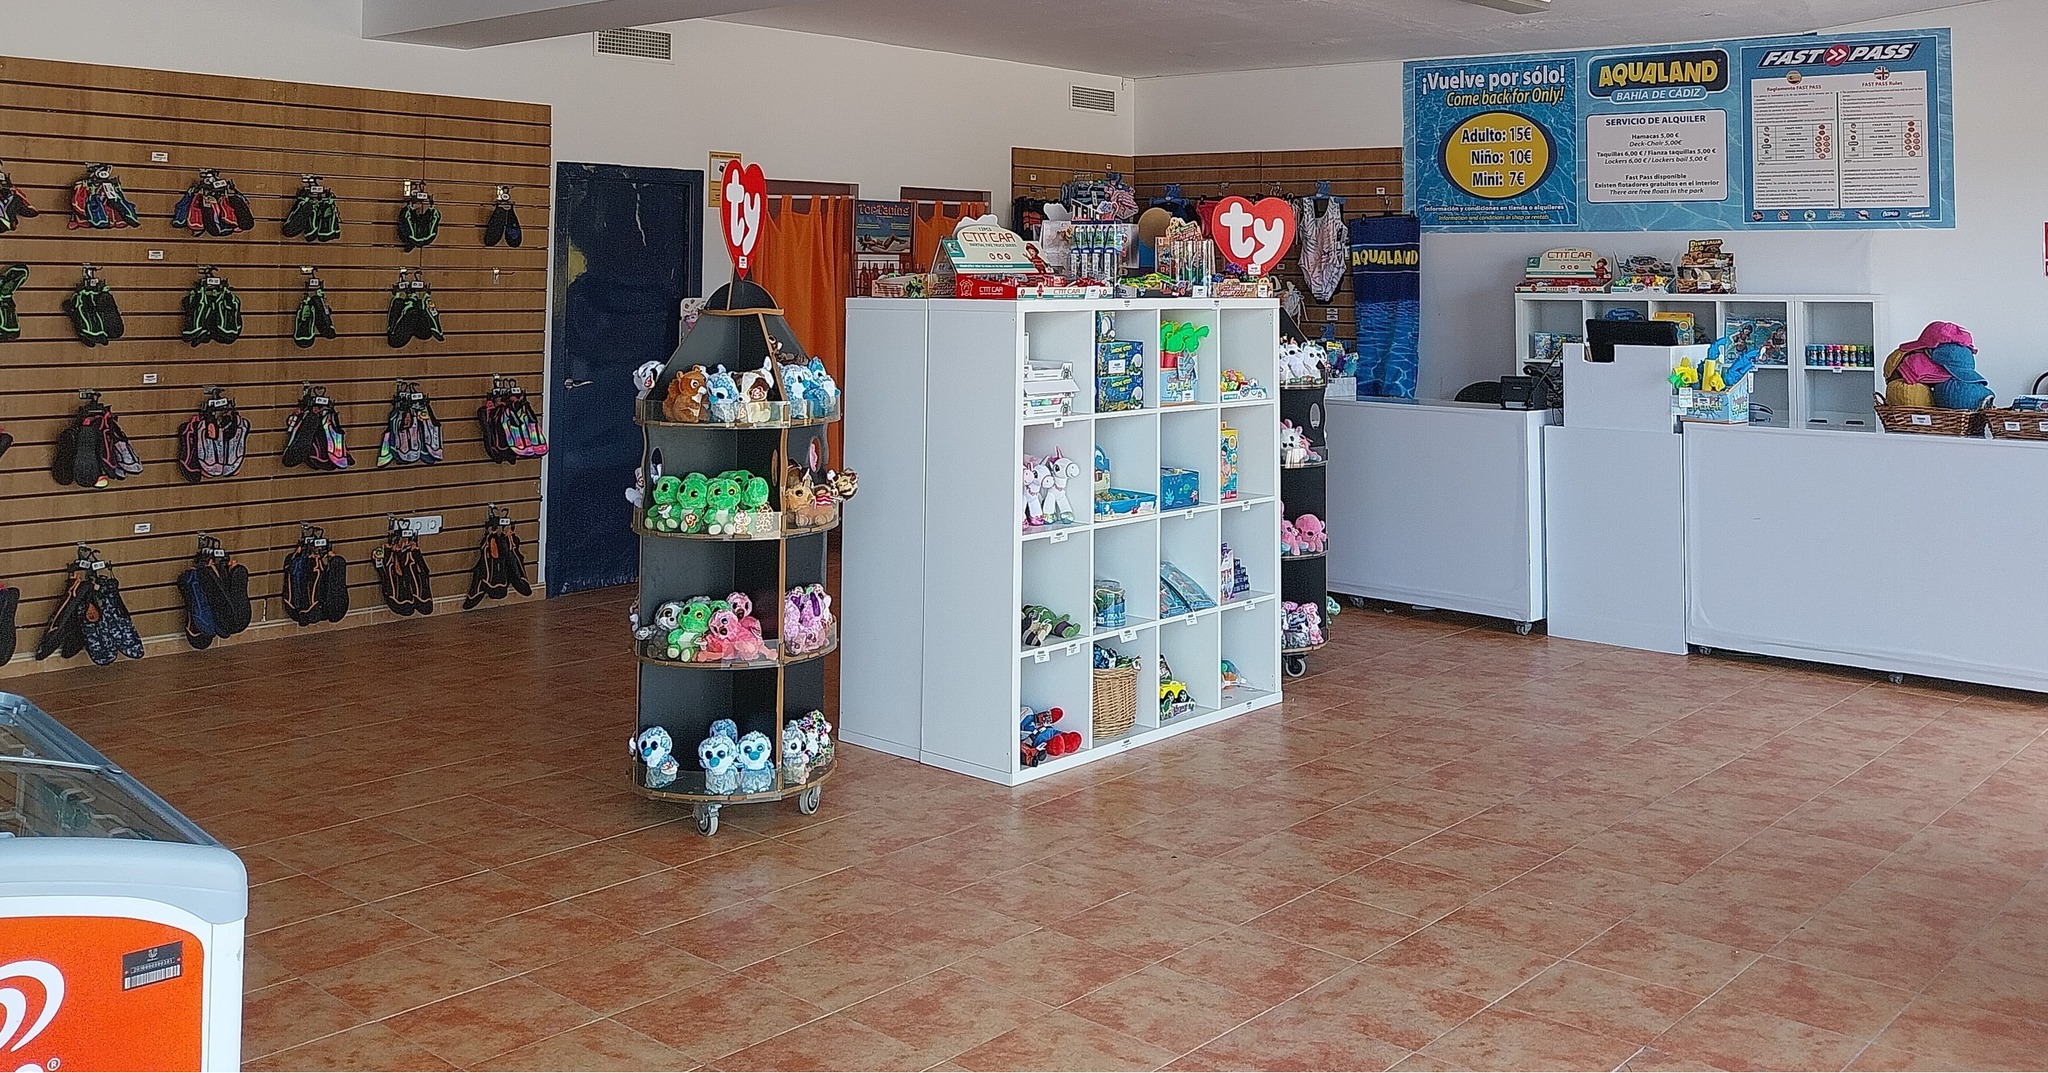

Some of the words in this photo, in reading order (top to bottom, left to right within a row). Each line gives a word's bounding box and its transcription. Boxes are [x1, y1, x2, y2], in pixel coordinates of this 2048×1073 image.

[1762, 49, 1826, 66] FAST
[1848, 43, 1914, 61] PASS
[1422, 69, 1485, 95] ¡Vuelve
[1488, 71, 1519, 92] por
[1523, 64, 1565, 86] sólo!
[1598, 60, 1719, 88] AQUALAND
[1446, 91, 1479, 107] Come
[1482, 88, 1509, 105] back
[1510, 87, 1530, 106] for
[1532, 86, 1565, 106] Only!
[1616, 89, 1649, 101] BAHÍA
[1651, 89, 1667, 100] DE
[1668, 87, 1702, 99] CÁDIZ
[1605, 118, 1646, 127] SERVICIO
[1647, 117, 1660, 125] DE
[1661, 115, 1706, 125] ALQUILER
[1461, 129, 1507, 144] Adulto:
[1509, 127, 1532, 141] 15€
[1470, 150, 1504, 165] Niño:
[1509, 150, 1533, 165] 10€
[1596, 150, 1624, 158] Taquillas
[1669, 148, 1696, 156] taquillas
[1472, 172, 1504, 187] Mini:
[1509, 171, 1525, 187] 7€
[1653, 172, 1687, 180] disponible
[1688, 187, 1704, 195] park
[726, 168, 761, 256] ty
[989, 231, 1016, 244] CAR
[1220, 201, 1285, 266] ty
[1352, 249, 1419, 267] AQUALAND
[1571, 251, 1592, 259] CAR
